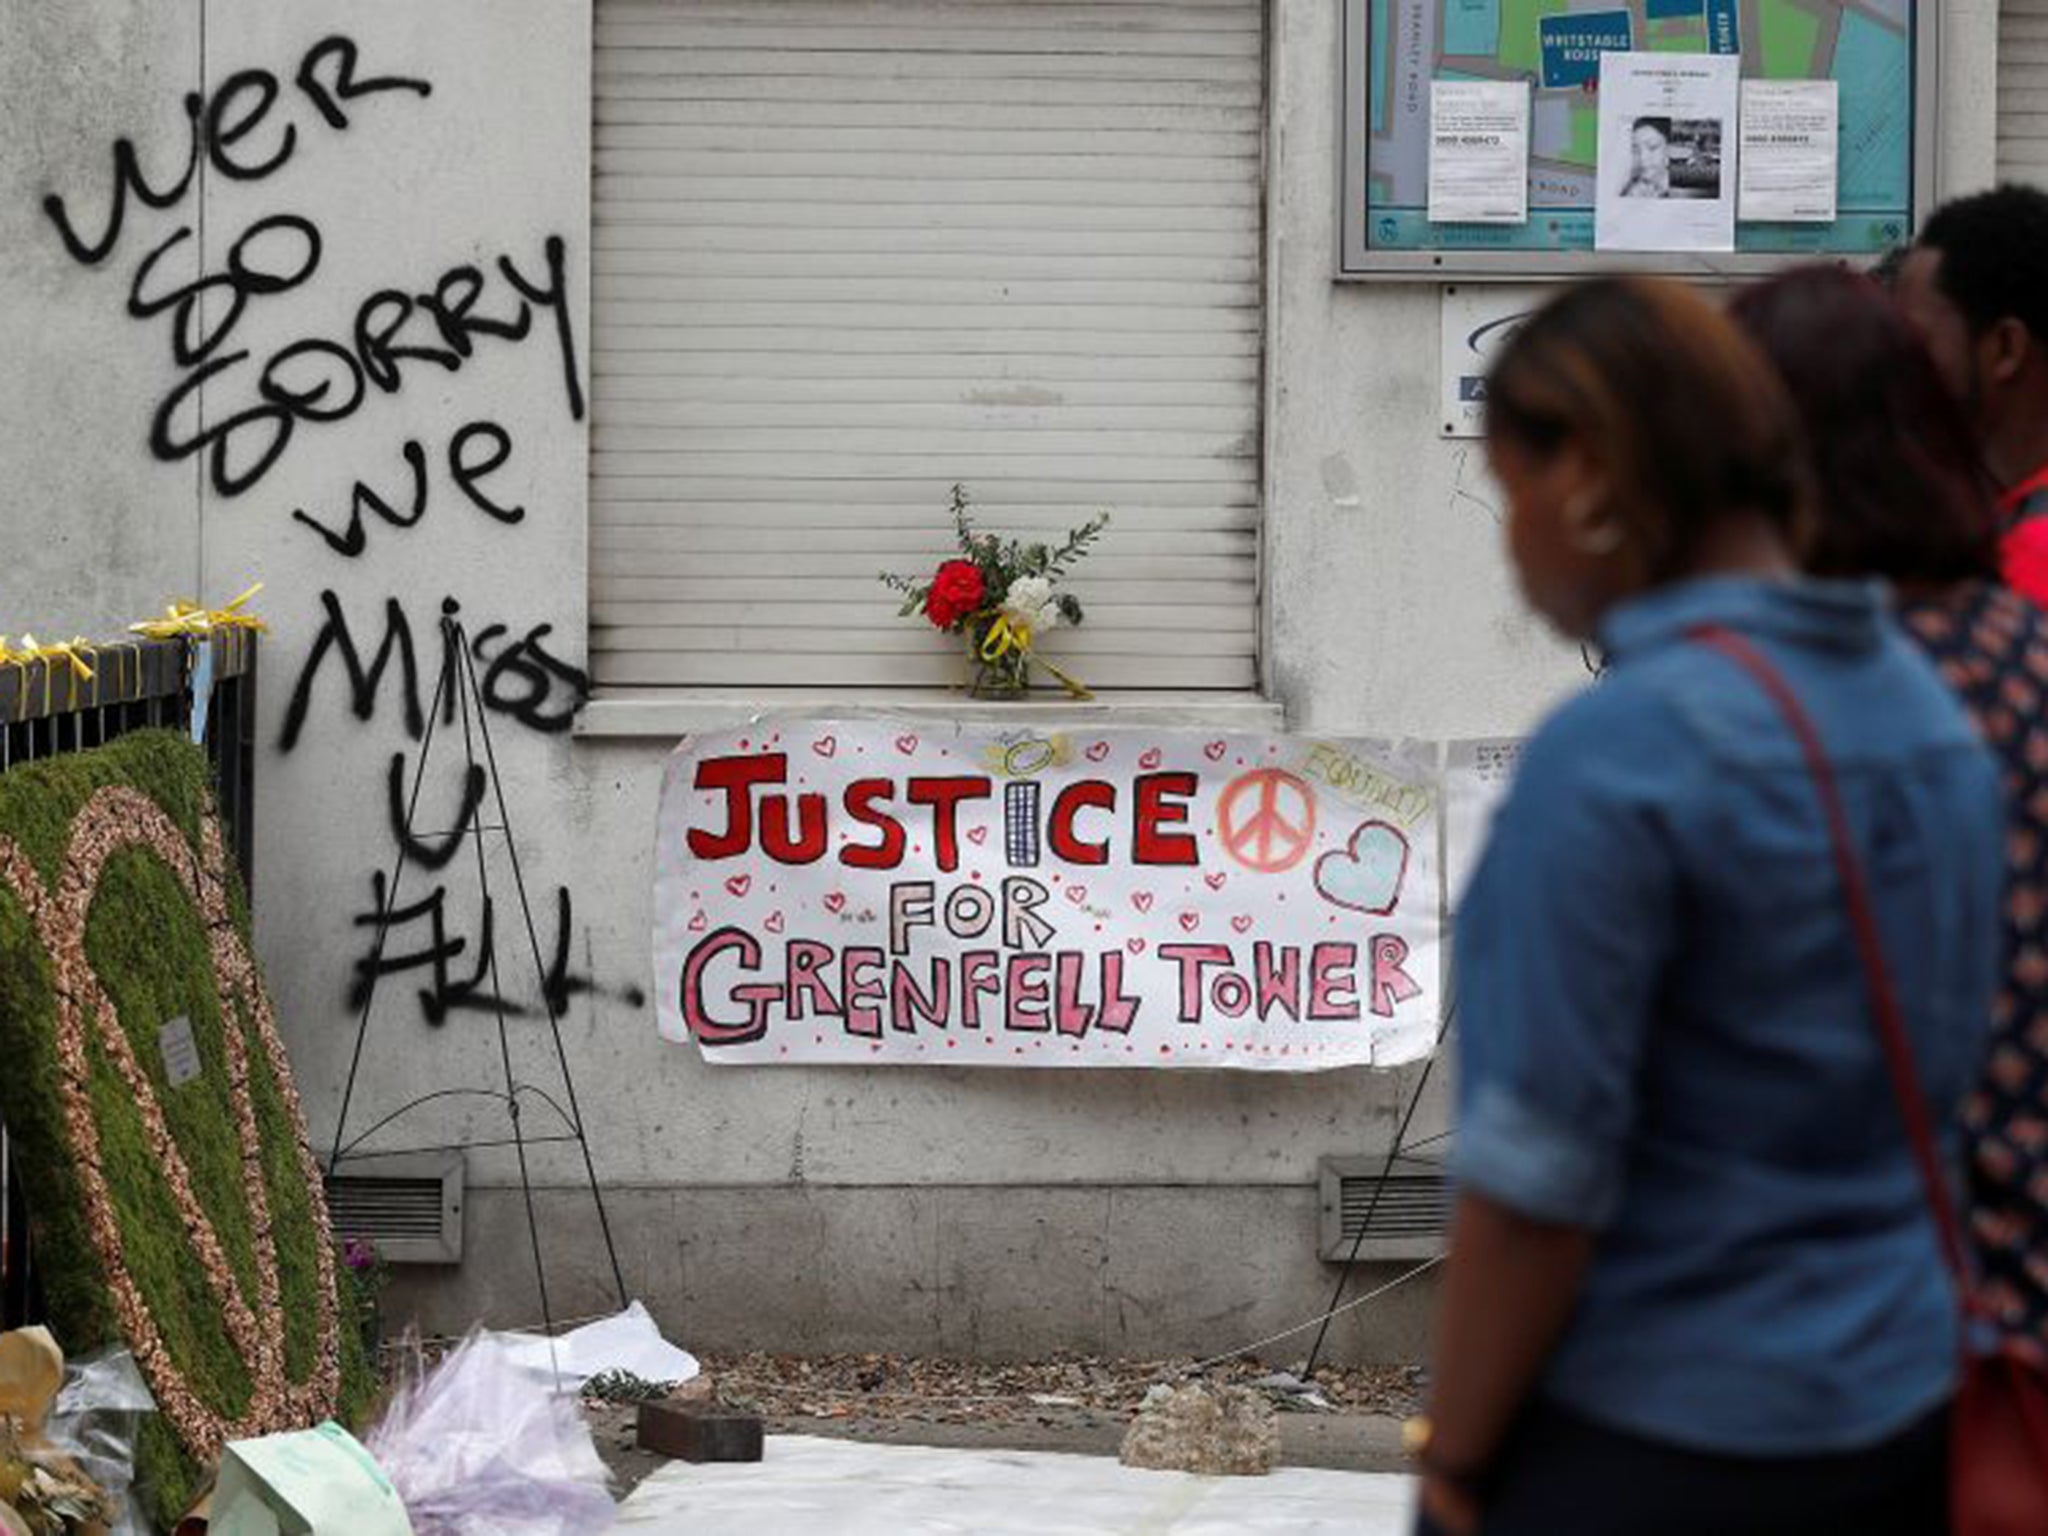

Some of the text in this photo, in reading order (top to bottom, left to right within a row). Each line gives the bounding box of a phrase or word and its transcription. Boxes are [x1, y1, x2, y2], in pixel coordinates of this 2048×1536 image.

[1542, 33, 1628, 48] WHITSTABLE
[1563, 48, 1599, 62] HOUS
[1406, 72, 1418, 113] ROAD
[388, 752, 487, 870] U
[686, 752, 1199, 873] JUSTICE
[889, 875, 1057, 955] FOR
[681, 926, 1423, 1046] GRENFELL TOWER
